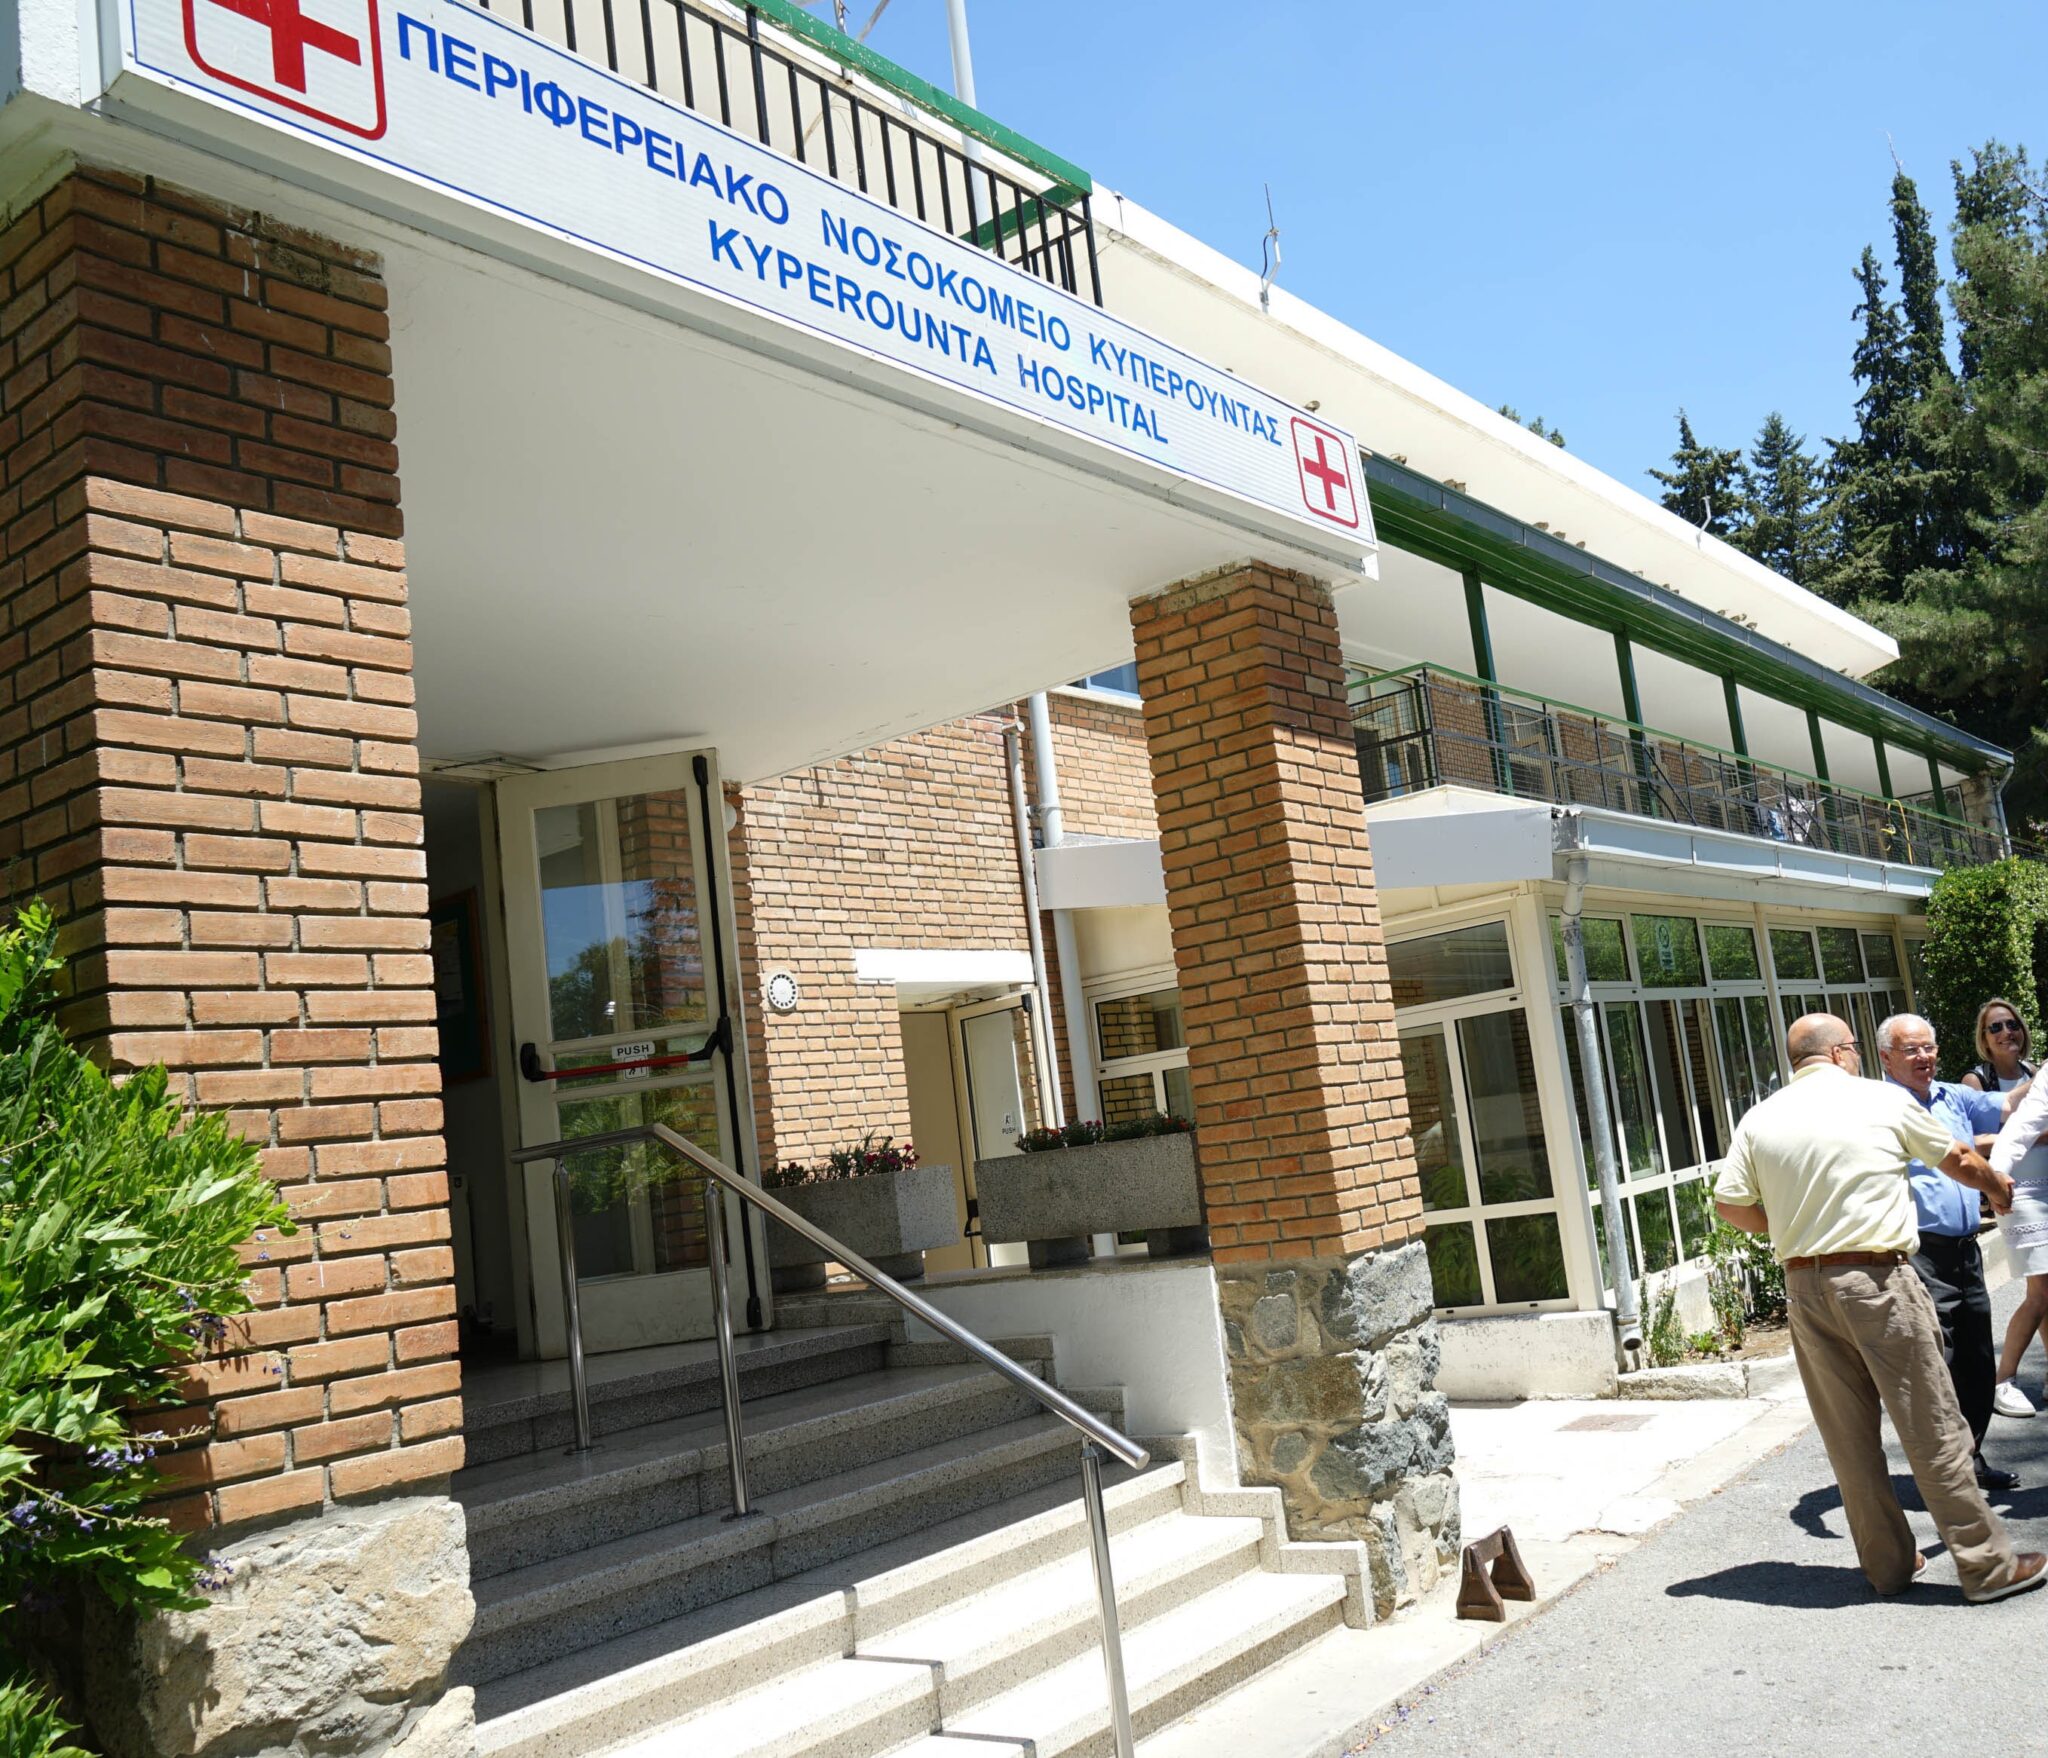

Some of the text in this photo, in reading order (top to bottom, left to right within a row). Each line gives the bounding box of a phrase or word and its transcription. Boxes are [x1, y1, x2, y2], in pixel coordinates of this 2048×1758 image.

[397, 12, 1282, 447] ΠΕΡΙΦΕΡΕΙΑΚΟ ΝΟΣΟΚΟΜΕΙΟ ΚΥΠΕΡΟΥΝΤΑΣ
[708, 219, 1168, 444] KYPEROUNTA HOSPITAL
[617, 1044, 649, 1056] PUSH
[1002, 1127, 1016, 1135] PUSH
